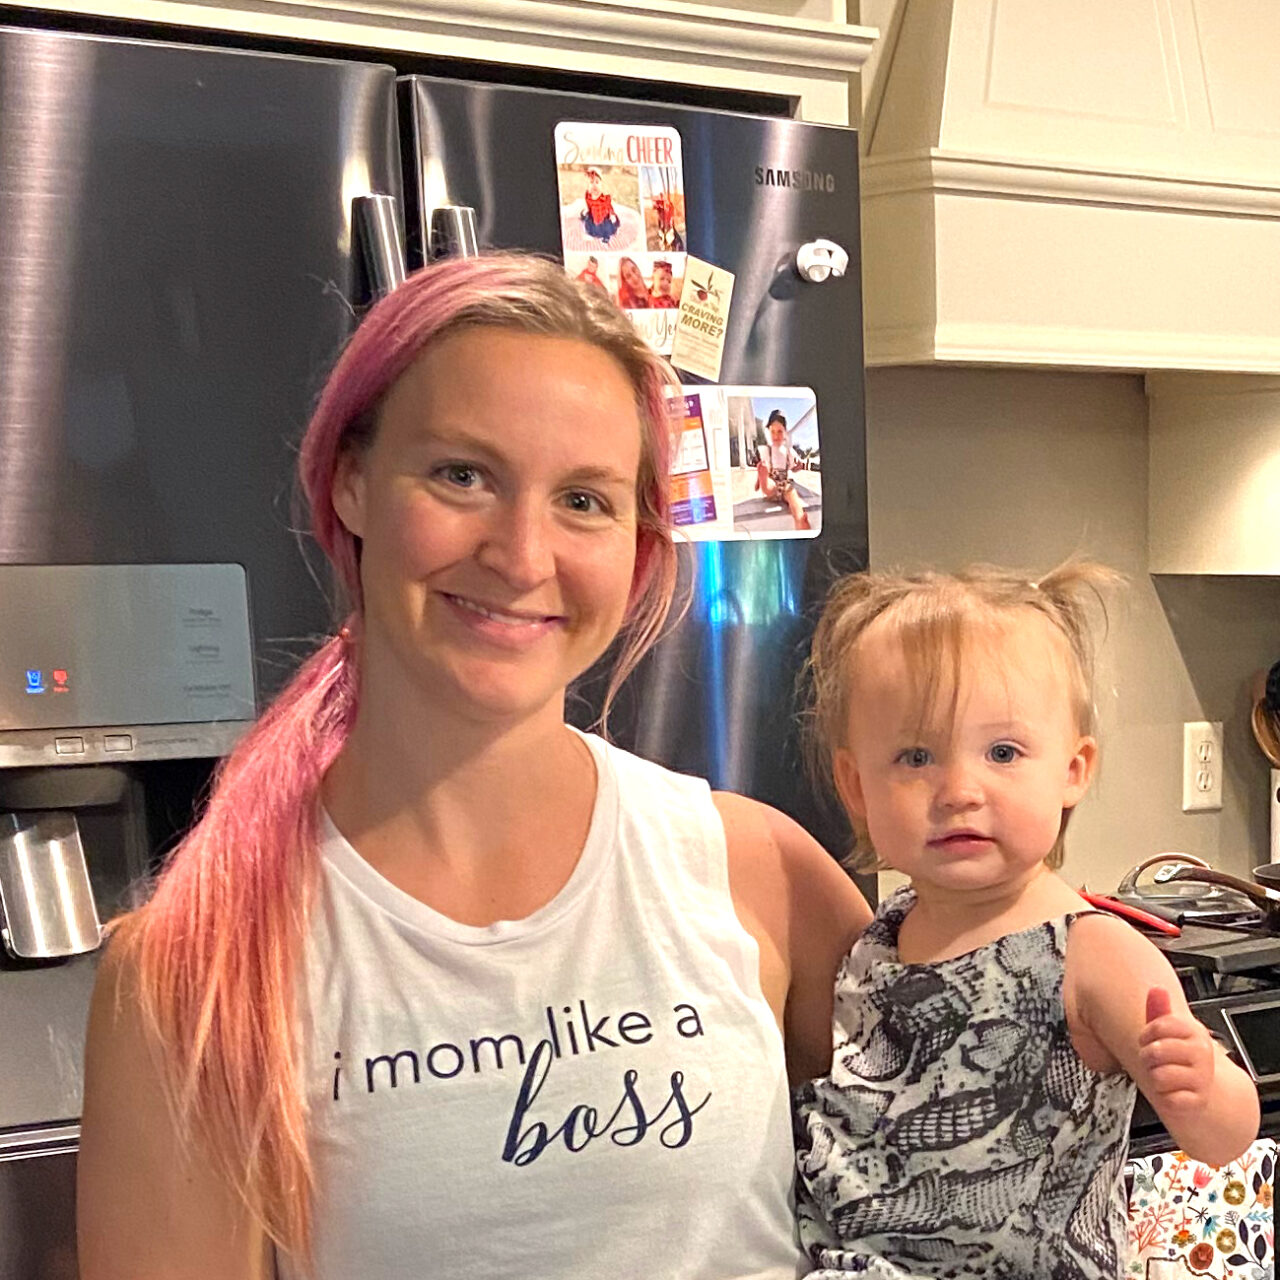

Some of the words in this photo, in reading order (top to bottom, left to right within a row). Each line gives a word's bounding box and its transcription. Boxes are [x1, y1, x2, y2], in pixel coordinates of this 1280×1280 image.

[626, 135, 674, 164] CHEER
[754, 165, 835, 192] SAMSUNG
[681, 303, 724, 326] CRAVING
[681, 314, 724, 339] MORE?
[333, 1051, 342, 1101] i
[365, 1033, 526, 1093] mom
[546, 999, 653, 1059] like
[673, 1003, 704, 1037] a
[501, 1039, 712, 1167] boss
